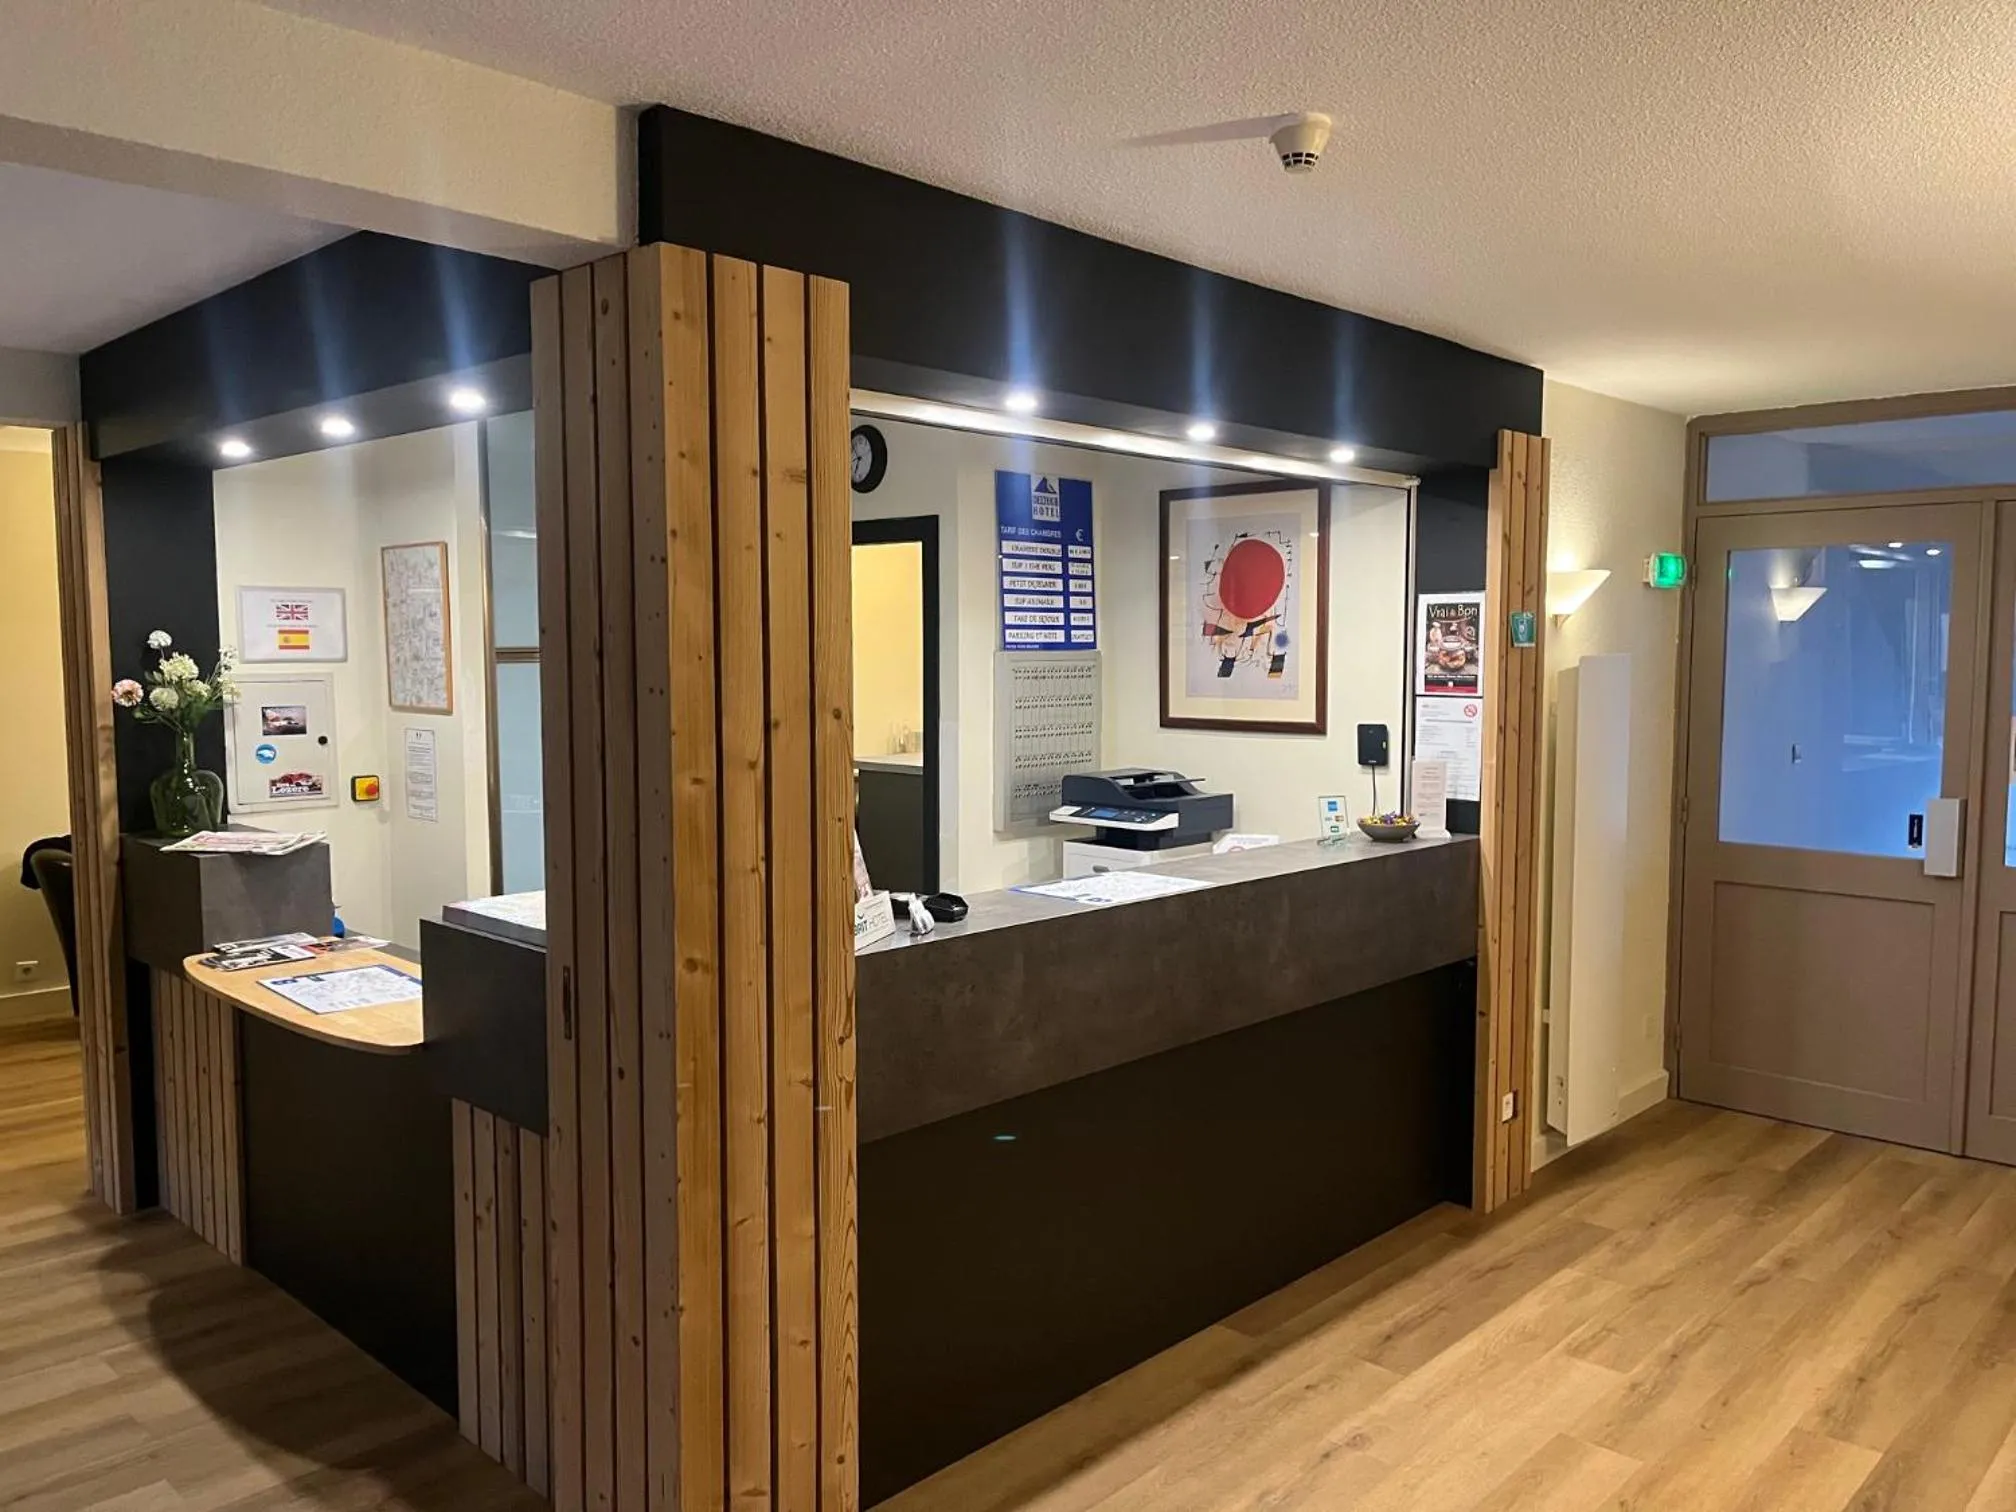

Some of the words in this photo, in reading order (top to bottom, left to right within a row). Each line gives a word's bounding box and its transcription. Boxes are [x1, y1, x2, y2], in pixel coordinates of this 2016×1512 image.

[1033, 506, 1059, 518] HOTEL
[1075, 528, 1084, 541] €
[1428, 605, 1449, 618] Vrai
[1457, 604, 1478, 617] Bon
